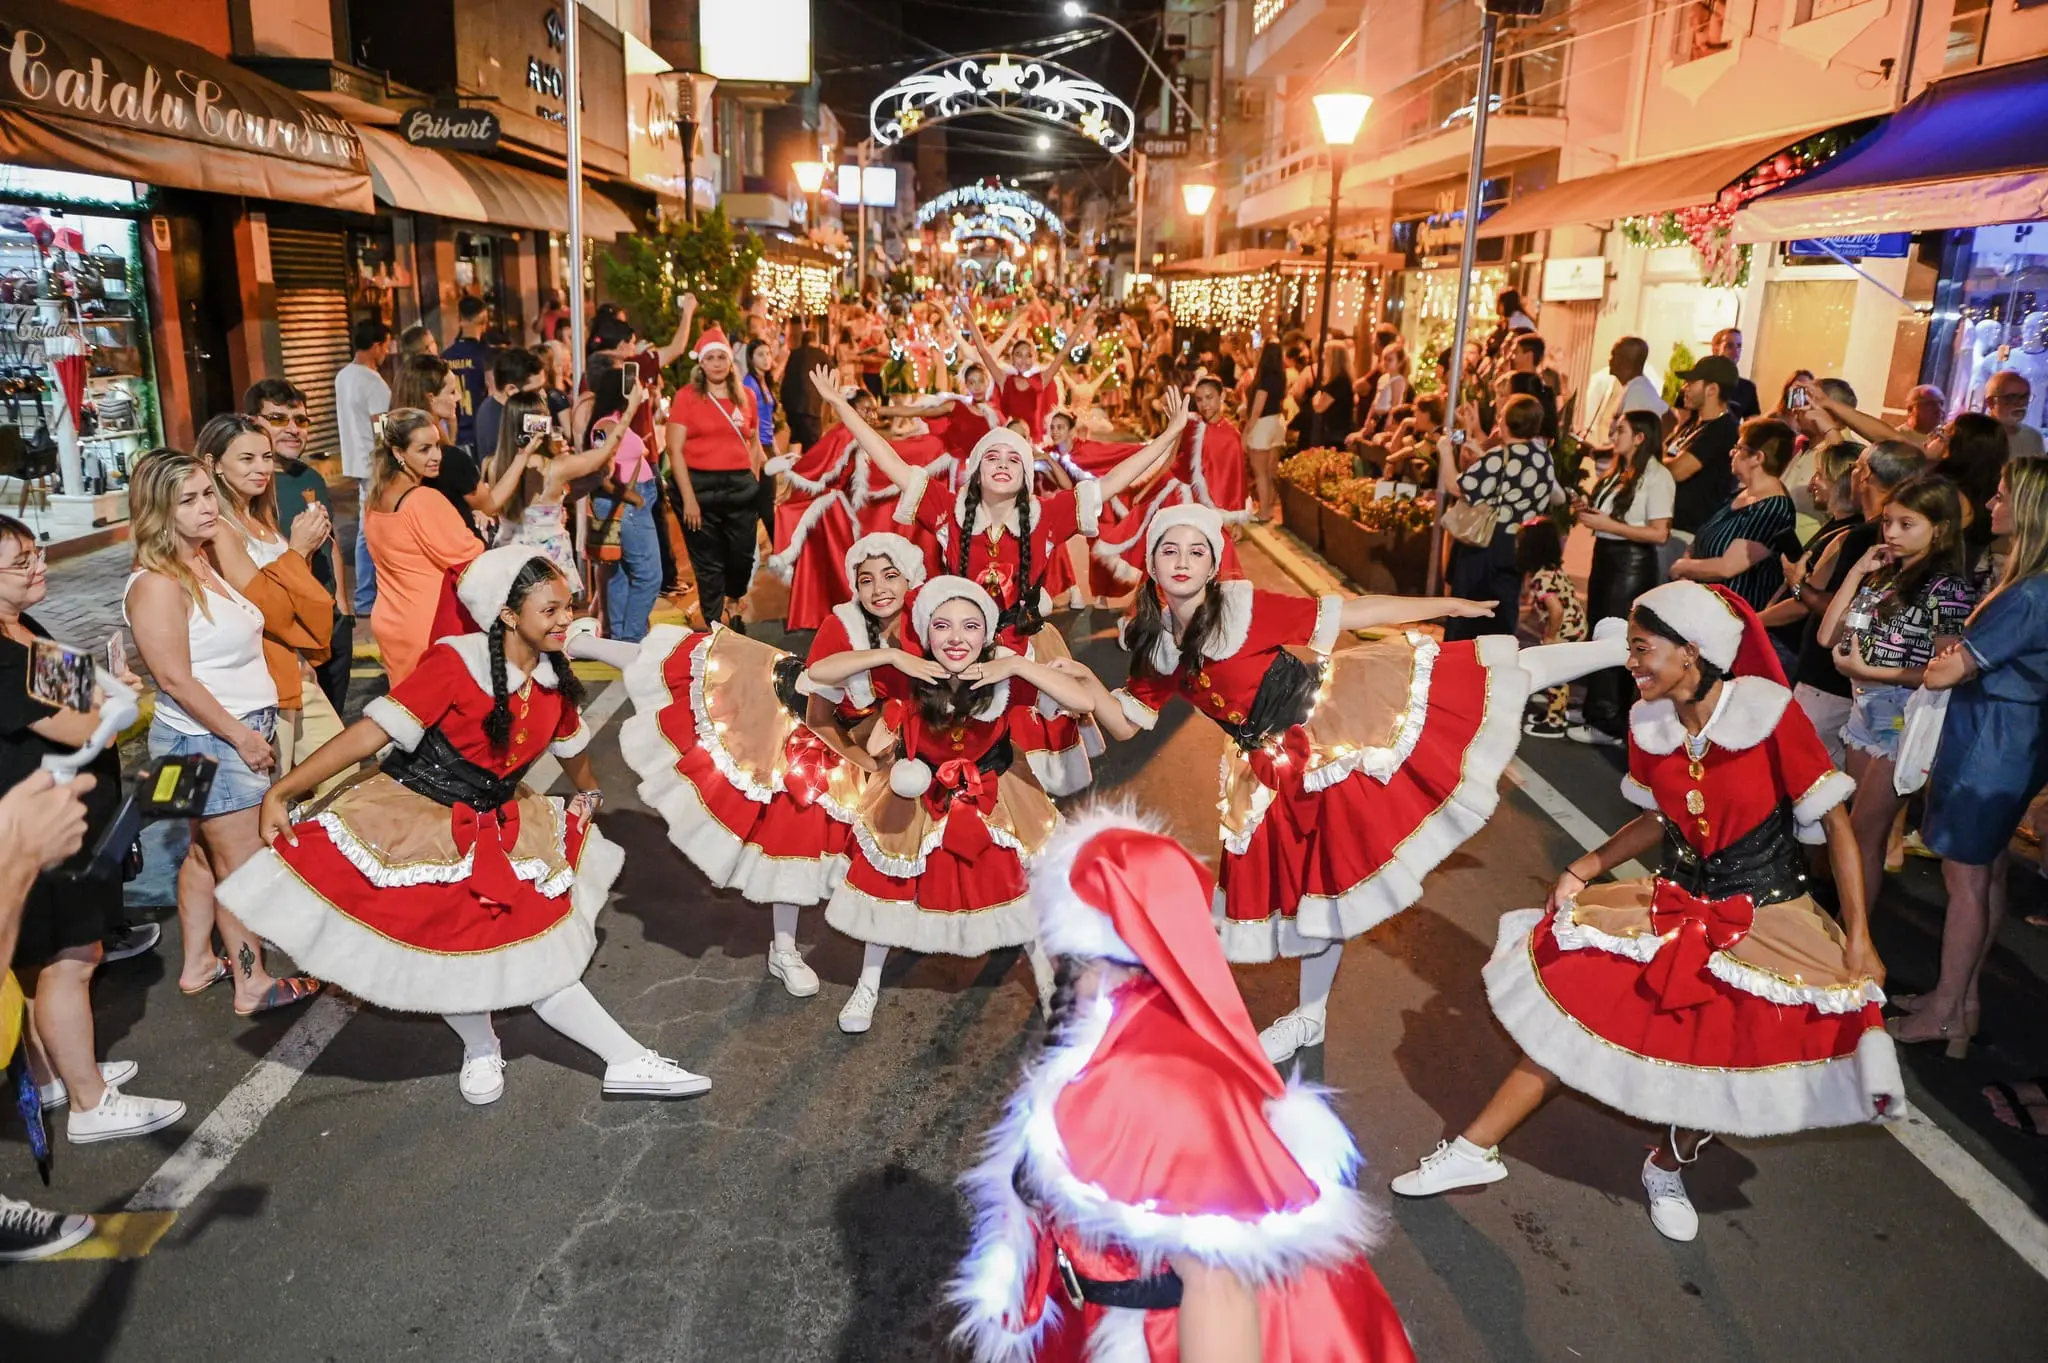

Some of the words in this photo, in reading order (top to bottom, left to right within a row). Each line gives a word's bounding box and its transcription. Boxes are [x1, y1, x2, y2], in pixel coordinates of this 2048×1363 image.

[176, 70, 314, 156] Couros
[407, 111, 492, 142] Crisart
[331, 135, 364, 160] LOJA
[1144, 140, 1187, 154] CONTI
[1874, 646, 1888, 658] LOVE
[1915, 639, 1931, 649] LOVE
